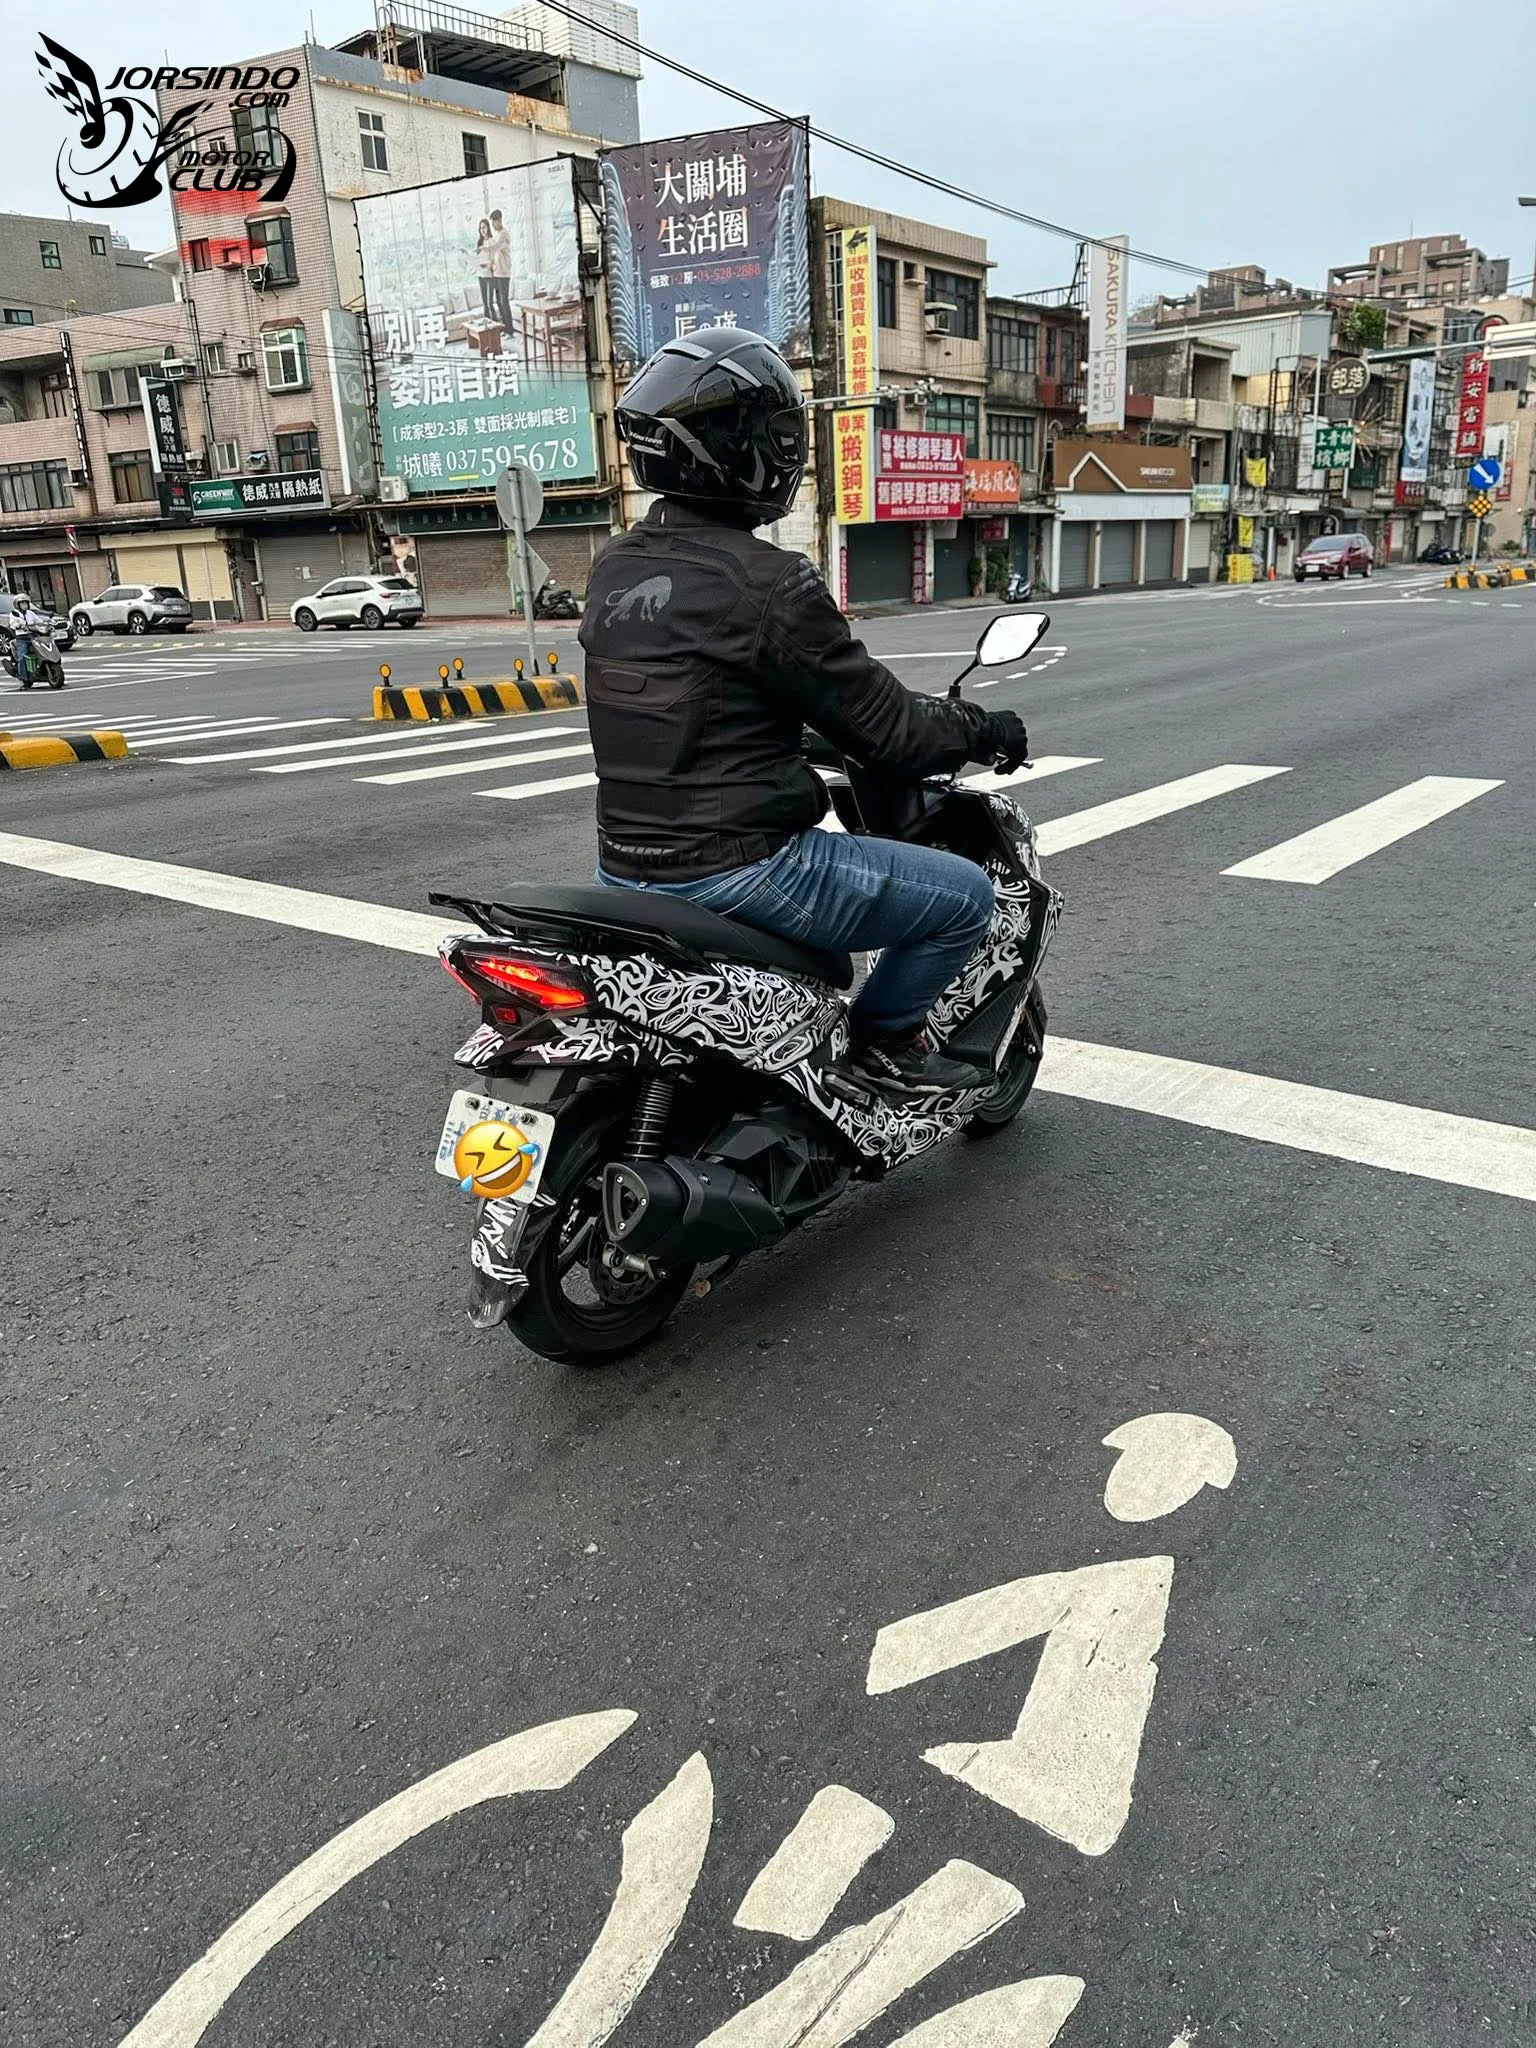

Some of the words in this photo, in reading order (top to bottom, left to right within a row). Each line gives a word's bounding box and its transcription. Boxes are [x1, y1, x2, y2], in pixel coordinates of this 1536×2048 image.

[653, 153, 747, 208] 大關埔
[657, 206, 748, 258] 生活圈
[1105, 250, 1120, 330] SAKURA
[385, 305, 449, 352] 別再
[1331, 367, 1364, 389] 部落
[156, 393, 175, 434] 德威
[242, 484, 269, 502] 德威
[281, 477, 322, 499] 隔熱紙
[841, 435, 863, 519] 搬鋼琴
